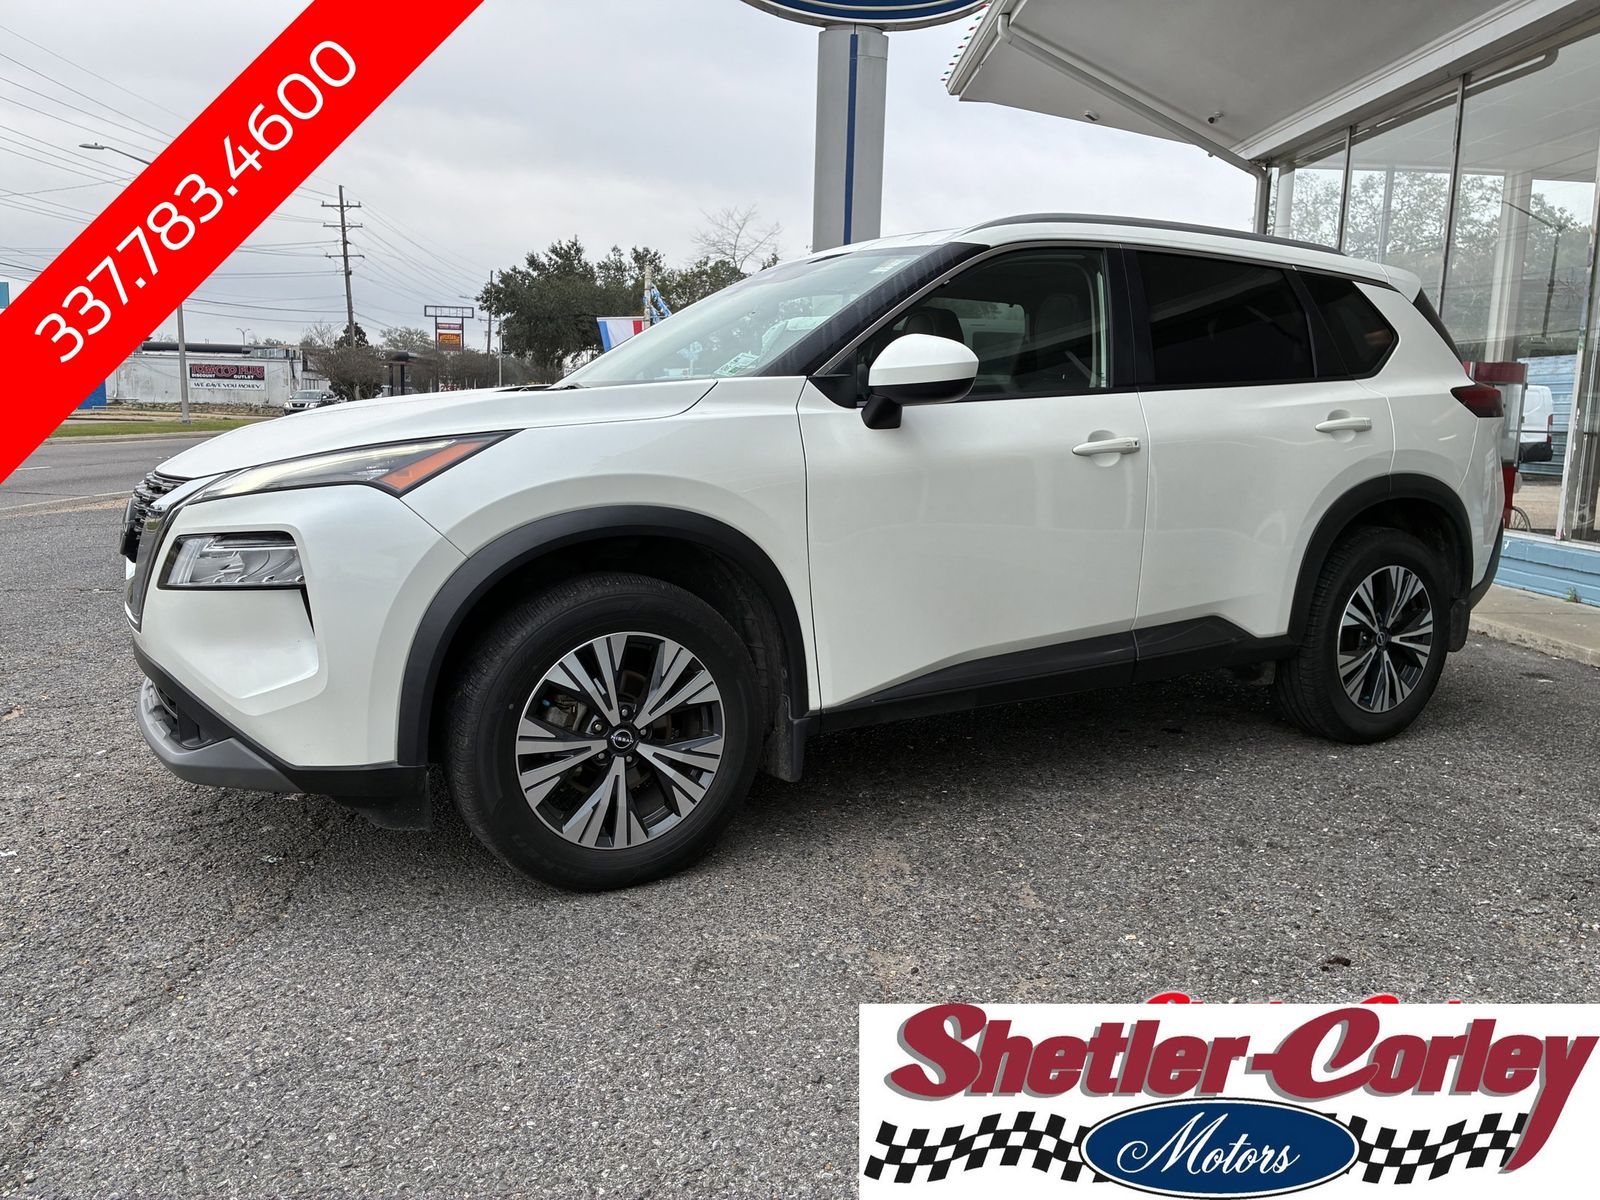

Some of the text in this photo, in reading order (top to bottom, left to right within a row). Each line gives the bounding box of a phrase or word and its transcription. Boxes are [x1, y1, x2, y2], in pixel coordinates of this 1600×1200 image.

[192, 364, 264, 378] TOBACCO PLUS
[611, 735, 634, 743] NISSAN
